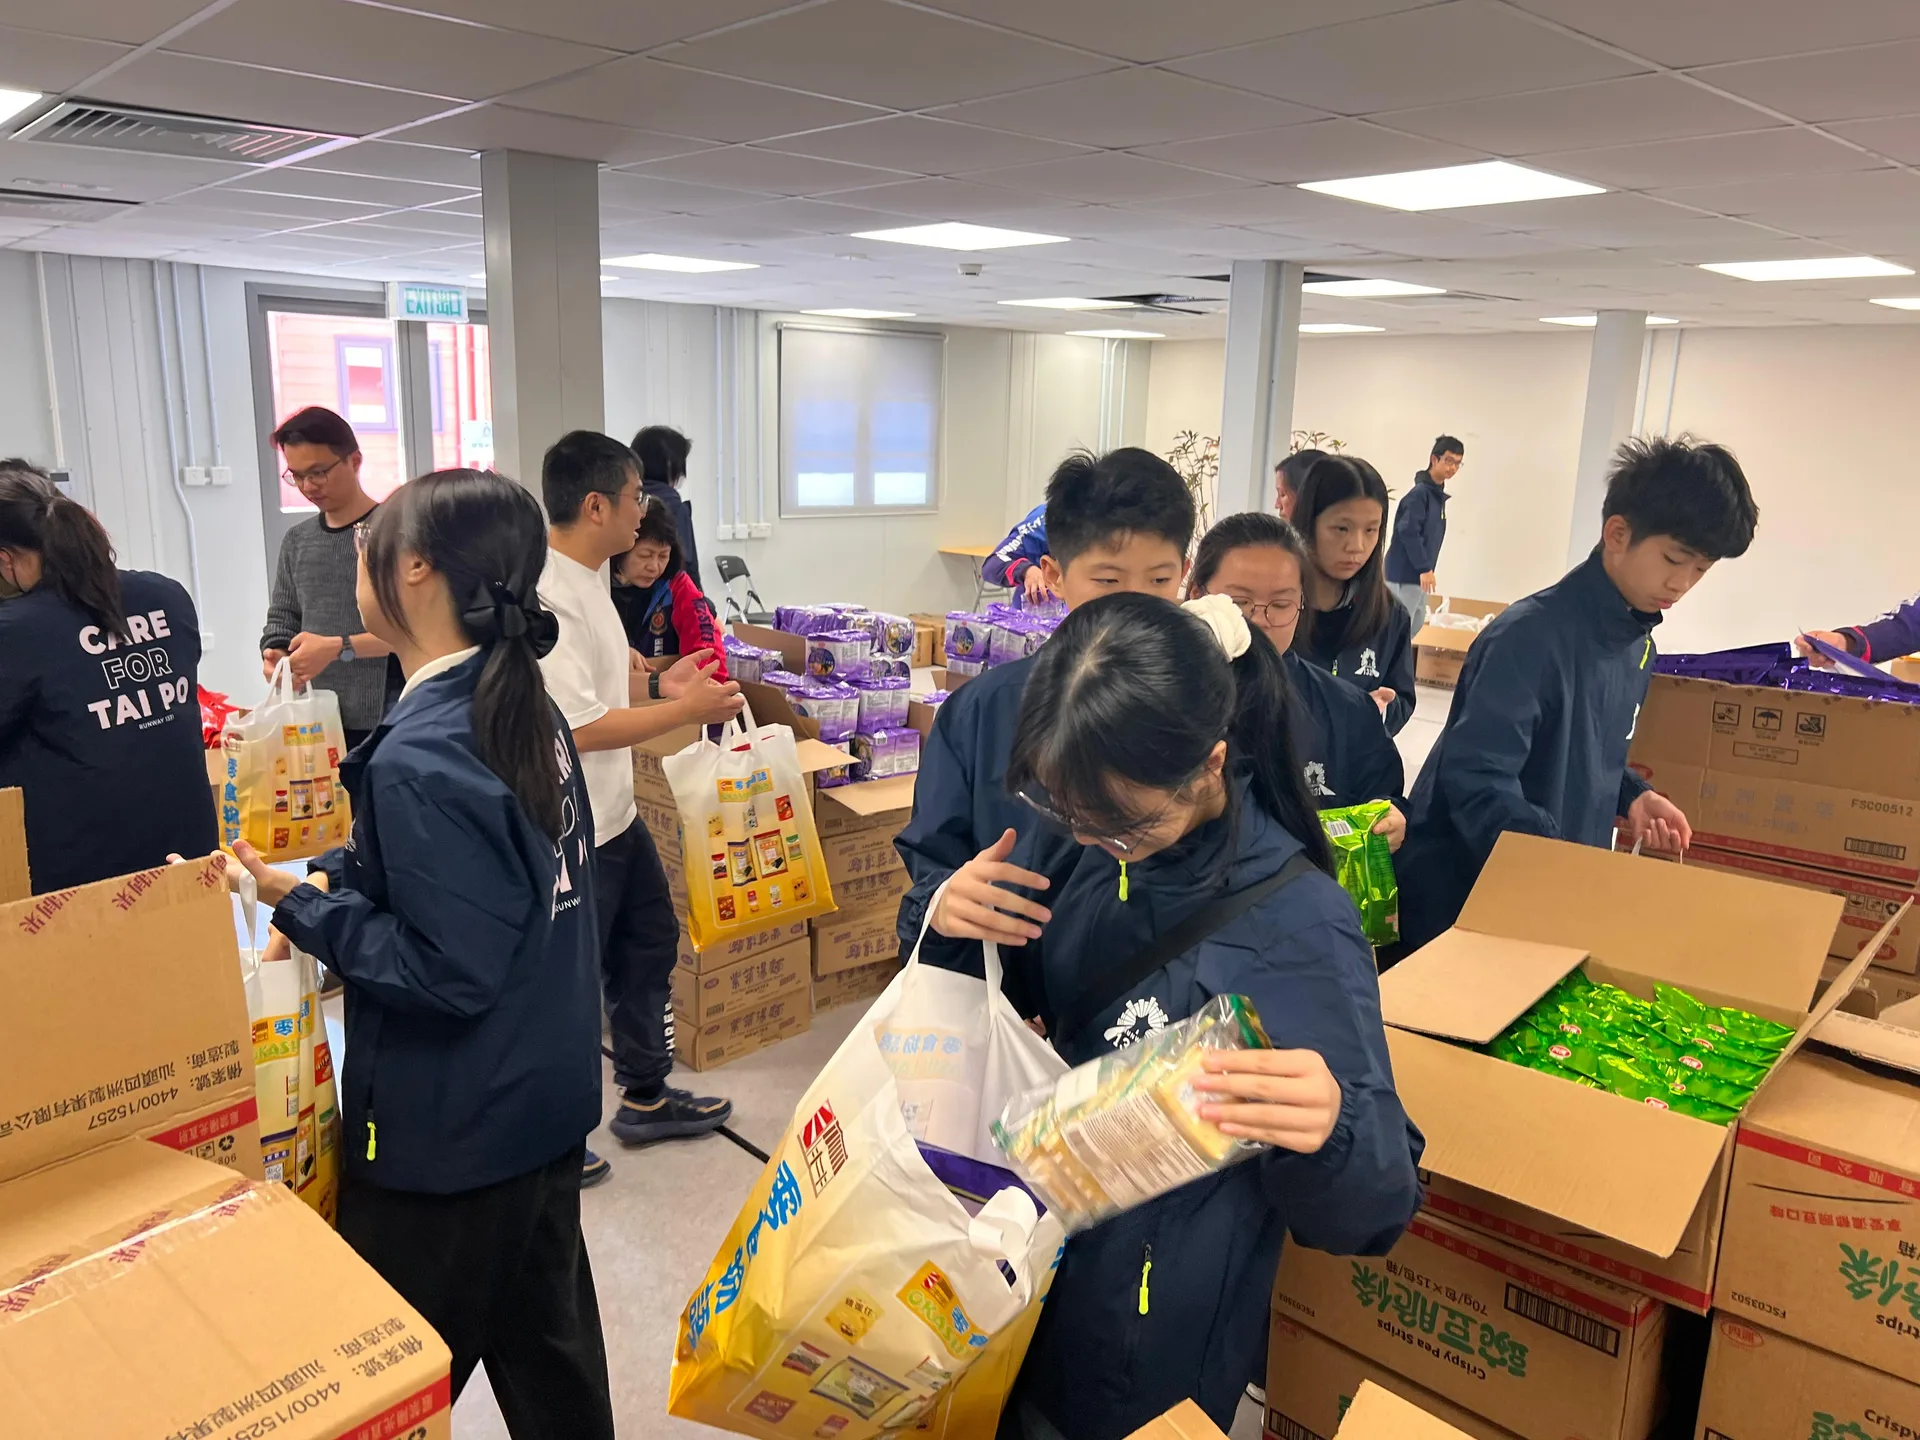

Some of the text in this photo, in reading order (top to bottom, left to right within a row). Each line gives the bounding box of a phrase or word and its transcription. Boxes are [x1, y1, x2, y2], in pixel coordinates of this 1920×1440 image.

[404, 287, 435, 316] EXIT
[102, 647, 173, 690] FOR
[88, 676, 190, 731] TAI PO
[138, 717, 165, 730] RUNWAY
[1850, 797, 1914, 818] FSC00512
[87, 1085, 179, 1131] 4400/15257
[1350, 1260, 1529, 1378] 豌豆脆條
[1731, 1291, 1787, 1319] FSC03502
[1876, 1313, 1920, 1340] trips
[1377, 1318, 1486, 1380] Crispy Pea Strips
[227, 1380, 341, 1440] 4400/1525
